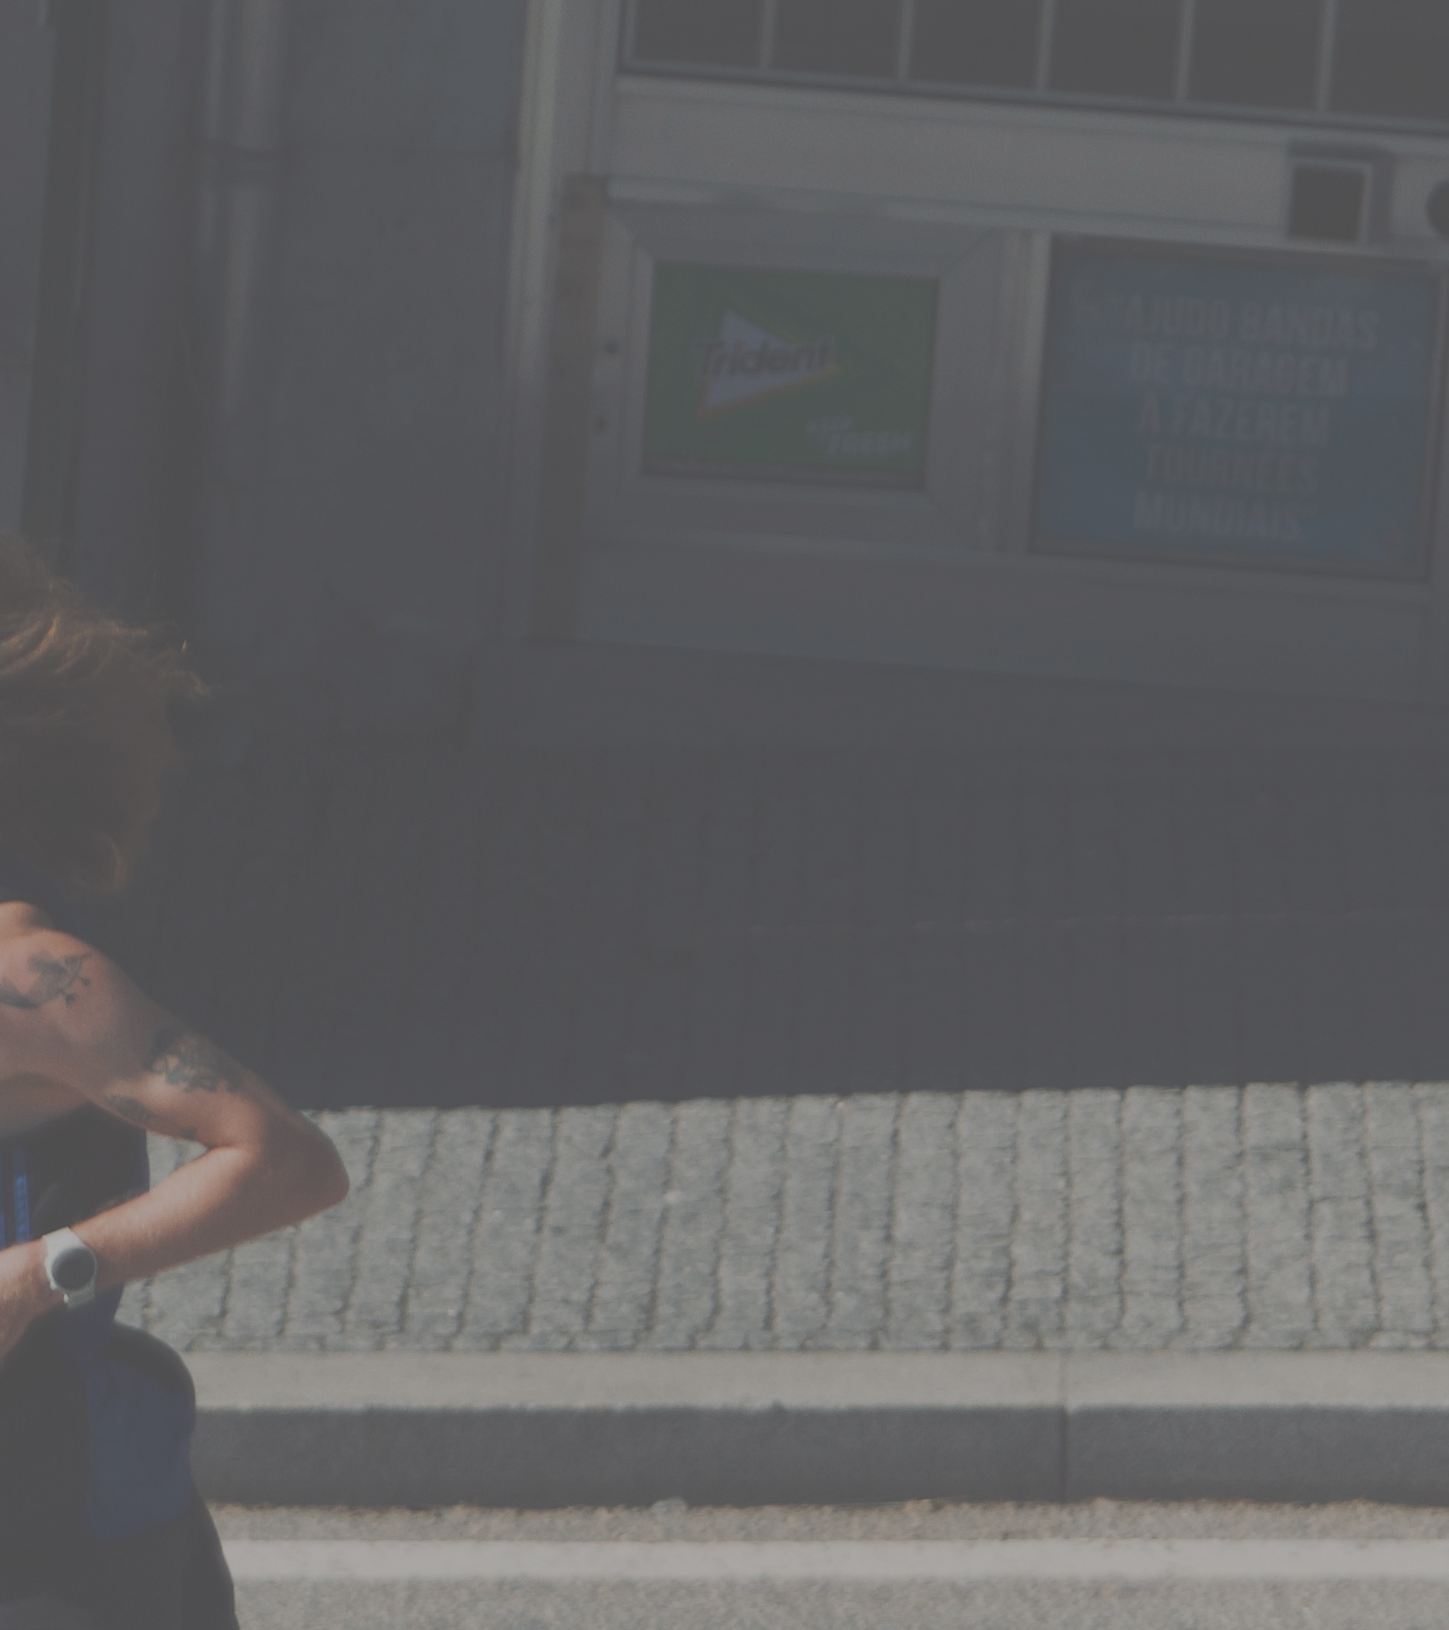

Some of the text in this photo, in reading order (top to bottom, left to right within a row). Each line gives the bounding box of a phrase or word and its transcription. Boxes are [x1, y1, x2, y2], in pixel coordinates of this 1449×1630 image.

[1239, 300, 1380, 354] BANDAS
[691, 335, 837, 378] Trident
[1127, 340, 1349, 397] DE GARAGEM
[1138, 391, 1331, 448] A FAZEREM
